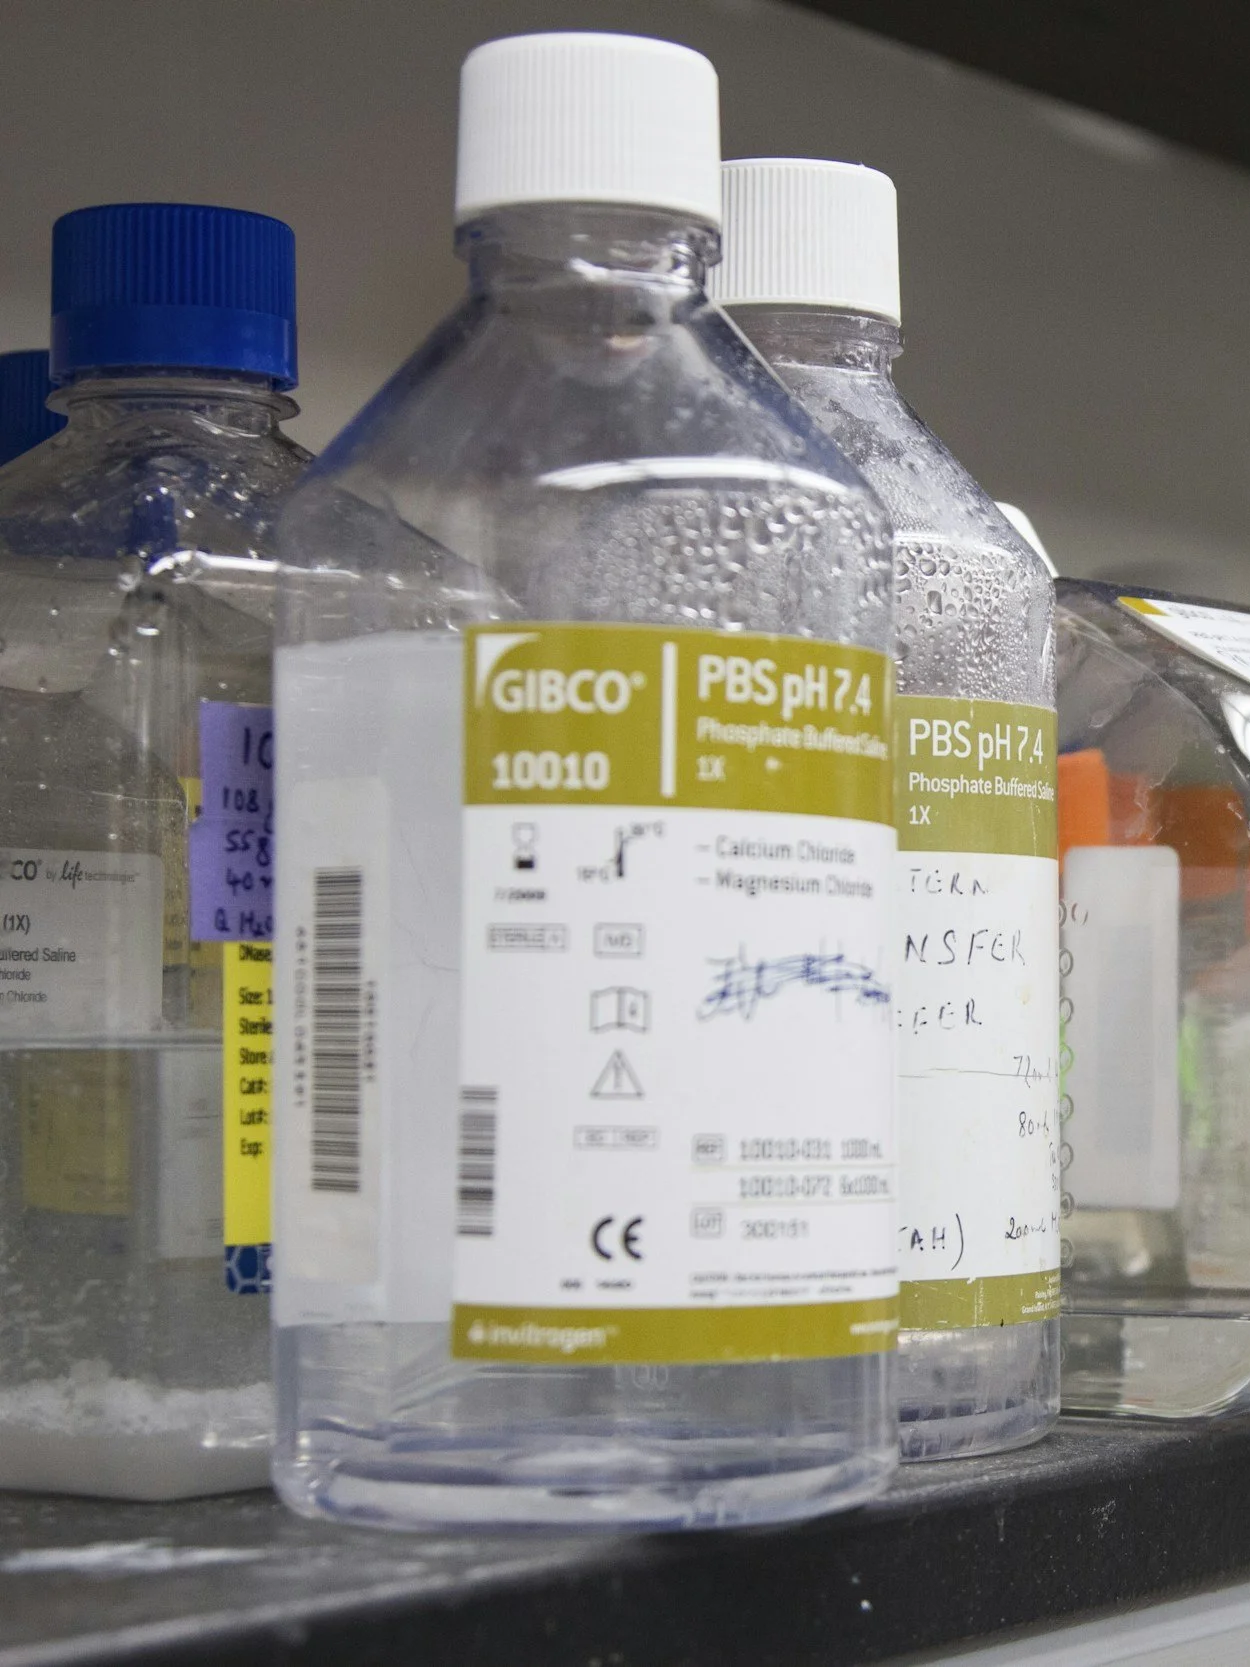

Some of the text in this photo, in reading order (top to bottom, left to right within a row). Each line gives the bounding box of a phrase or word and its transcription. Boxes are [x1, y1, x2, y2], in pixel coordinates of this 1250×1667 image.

[699, 654, 776, 705] PBS
[781, 664, 828, 721] pH
[832, 668, 871, 715] 7.4
[697, 715, 800, 753] Phosphate
[909, 718, 1043, 771] PBS pH 7.4
[492, 750, 611, 791] 10010
[909, 771, 1055, 802] Phosphate Buffered Saline
[909, 805, 932, 825] 1X
[715, 834, 856, 864] Calcium Chloride
[60, 859, 83, 890] life
[716, 868, 820, 899] Magnesium
[2, 913, 32, 936] (1X)
[42, 947, 77, 963] Saline
[239, 1046, 267, 1065] Store
